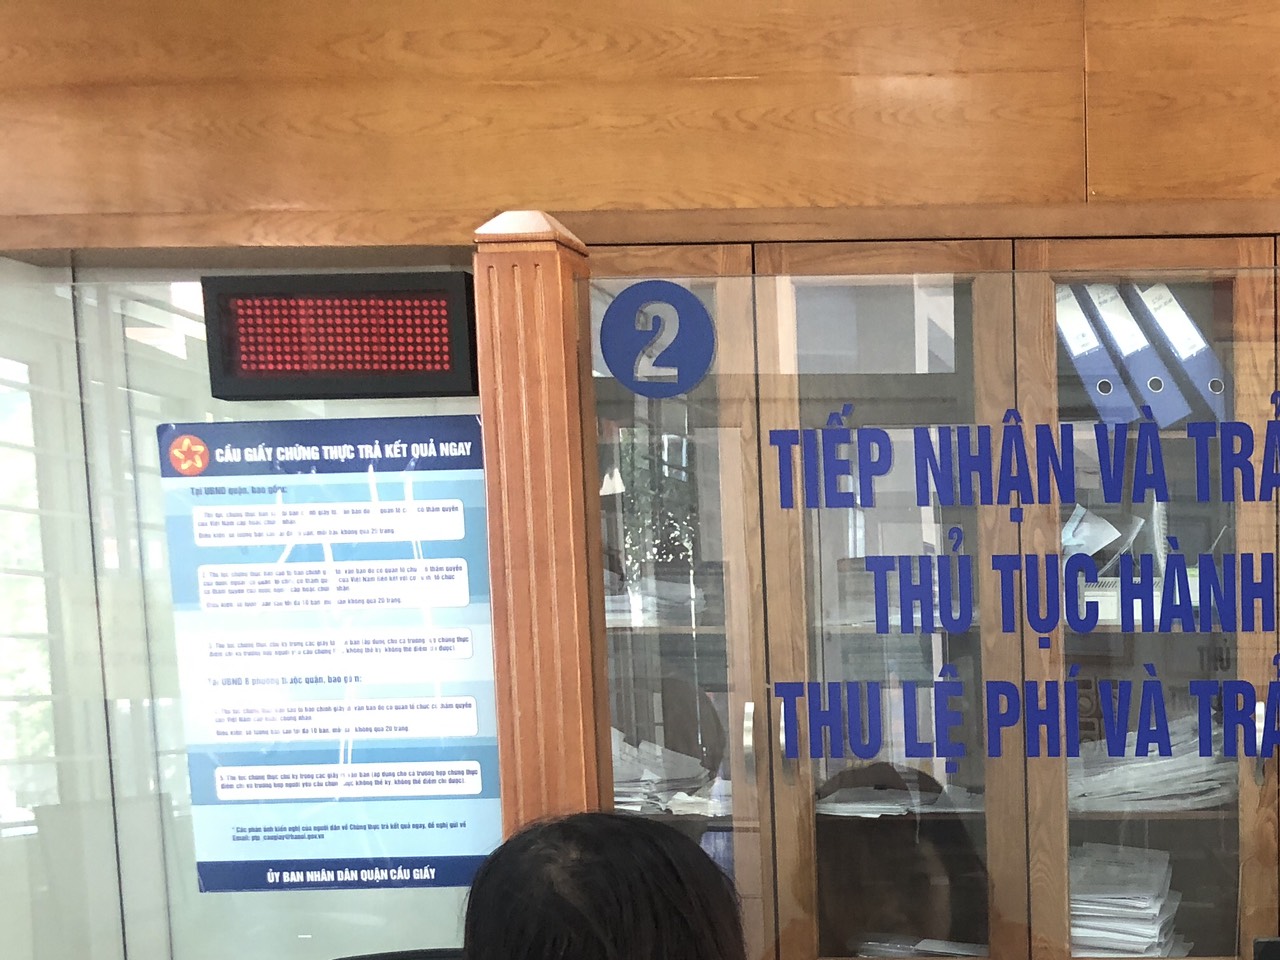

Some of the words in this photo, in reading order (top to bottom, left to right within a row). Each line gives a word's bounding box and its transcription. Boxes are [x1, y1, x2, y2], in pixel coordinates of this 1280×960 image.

[633, 301, 680, 384] 2
[244, 442, 274, 462] GIẤY
[276, 443, 320, 461] CHỨNG
[322, 443, 355, 462] THỰC
[357, 440, 383, 459] TRẢ
[384, 439, 408, 458] KẾT
[411, 438, 437, 459] QUẢ
[439, 441, 472, 457] NGAY
[769, 404, 893, 509] TIẾP
[913, 409, 1076, 523] NHẬN
[1093, 405, 1170, 504] VÀ
[865, 526, 974, 635] THỦ
[991, 552, 1099, 649] TỤC
[1119, 534, 1275, 633] HÀNH
[774, 681, 883, 760] THU
[902, 663, 966, 774] LỆ
[986, 663, 1082, 759] PHÍ
[1097, 663, 1174, 759] VÀ
[266, 868, 280, 883] ỦY
[282, 871, 304, 883] BAN
[305, 868, 335, 883] NHÂN
[336, 867, 359, 882] DÂN
[360, 867, 388, 883] QUẬN
[412, 864, 436, 880] GIẤY
